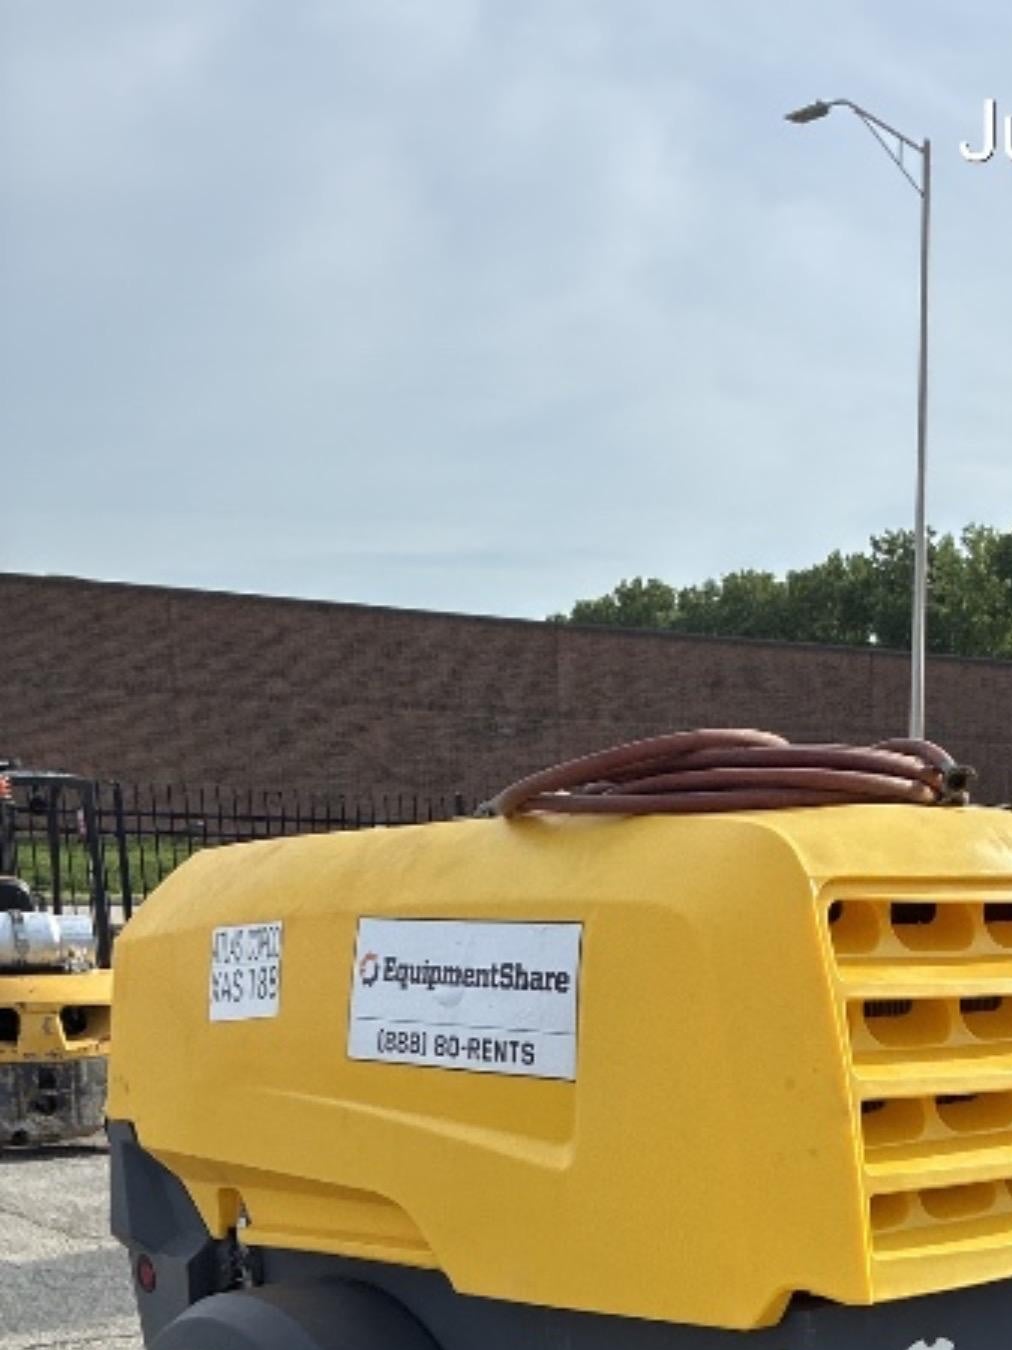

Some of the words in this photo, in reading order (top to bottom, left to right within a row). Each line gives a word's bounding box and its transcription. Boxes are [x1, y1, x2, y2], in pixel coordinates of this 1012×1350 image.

[382, 956, 571, 994] EquipmentShare
[376, 1027, 428, 1057] (888)
[433, 1033, 536, 1066] 80-RENTS
